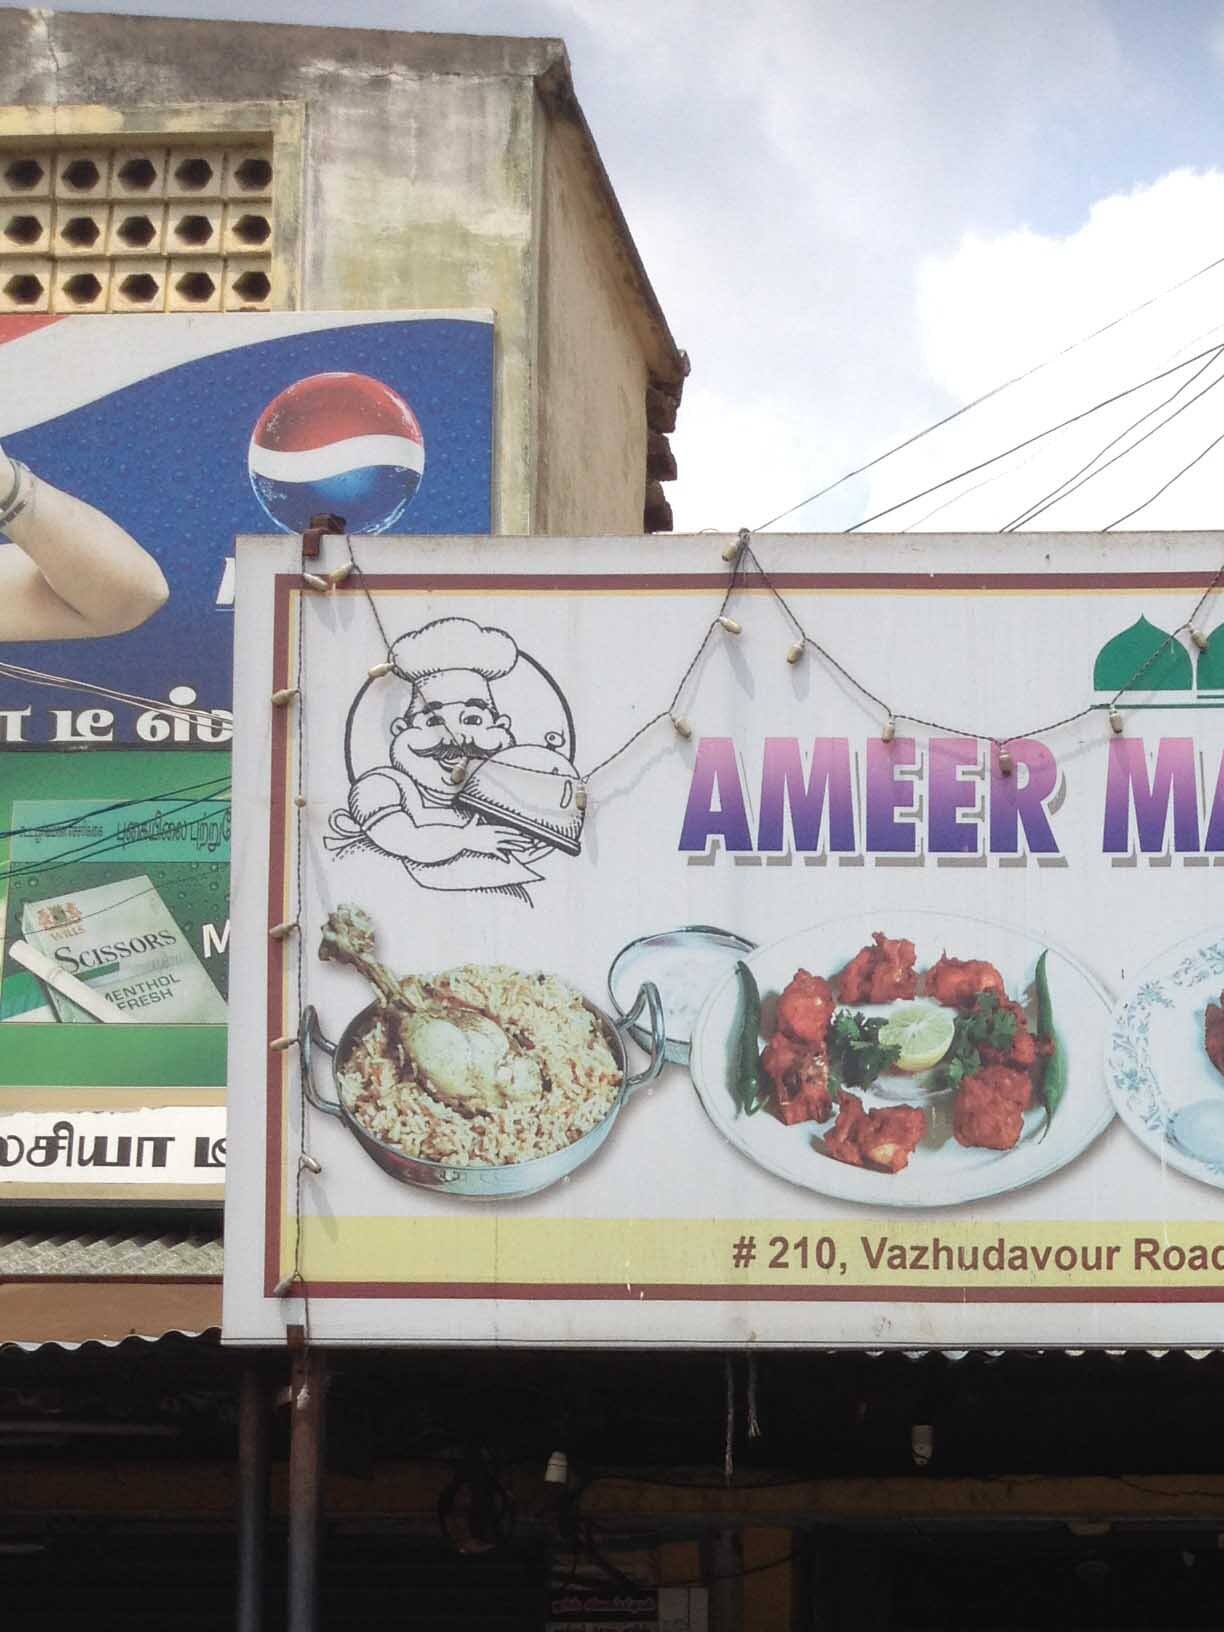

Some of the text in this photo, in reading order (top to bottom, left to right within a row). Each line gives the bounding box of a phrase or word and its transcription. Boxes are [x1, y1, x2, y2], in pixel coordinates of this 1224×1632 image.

[677, 735, 1062, 854] AMEER
[733, 1236, 756, 1268] #
[769, 1237, 847, 1274] 210,
[860, 1236, 1120, 1271] Vazhudavour
